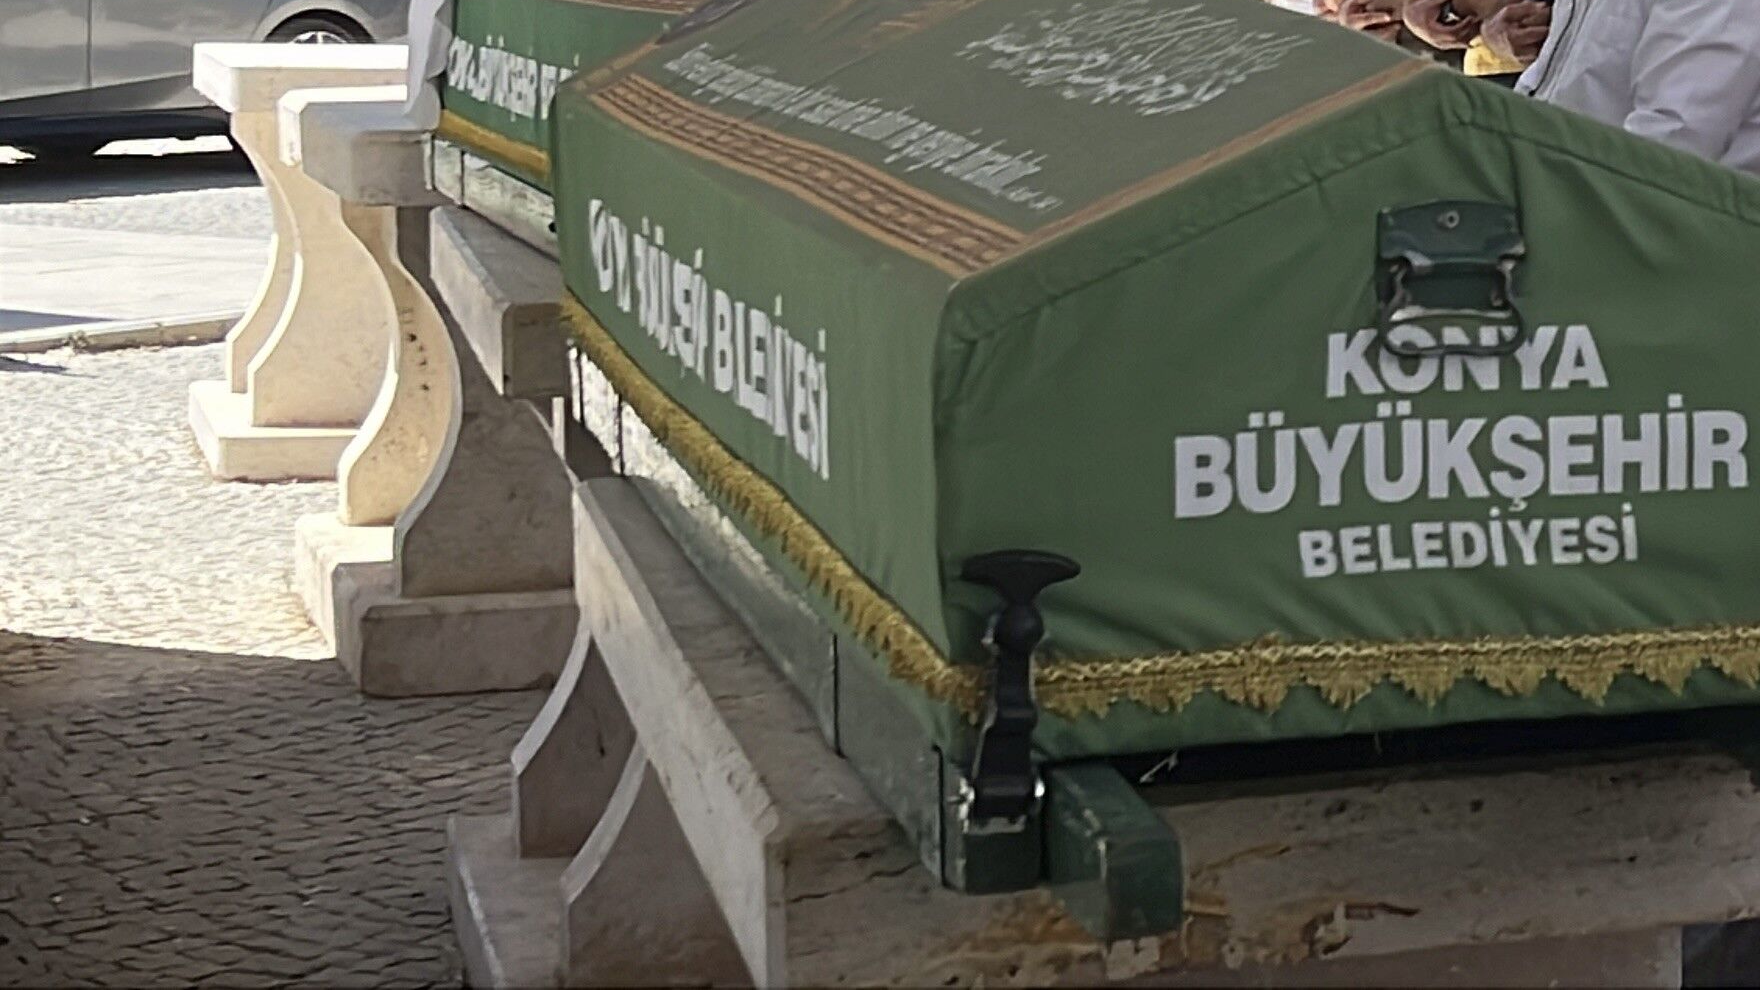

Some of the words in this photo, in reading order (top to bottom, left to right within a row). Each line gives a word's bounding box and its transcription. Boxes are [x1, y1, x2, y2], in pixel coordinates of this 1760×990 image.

[1325, 323, 1609, 398] KONYA
[1174, 393, 1749, 518] BÜYÜKŞEHİR
[1298, 503, 1638, 578] BELEDİYESİ
